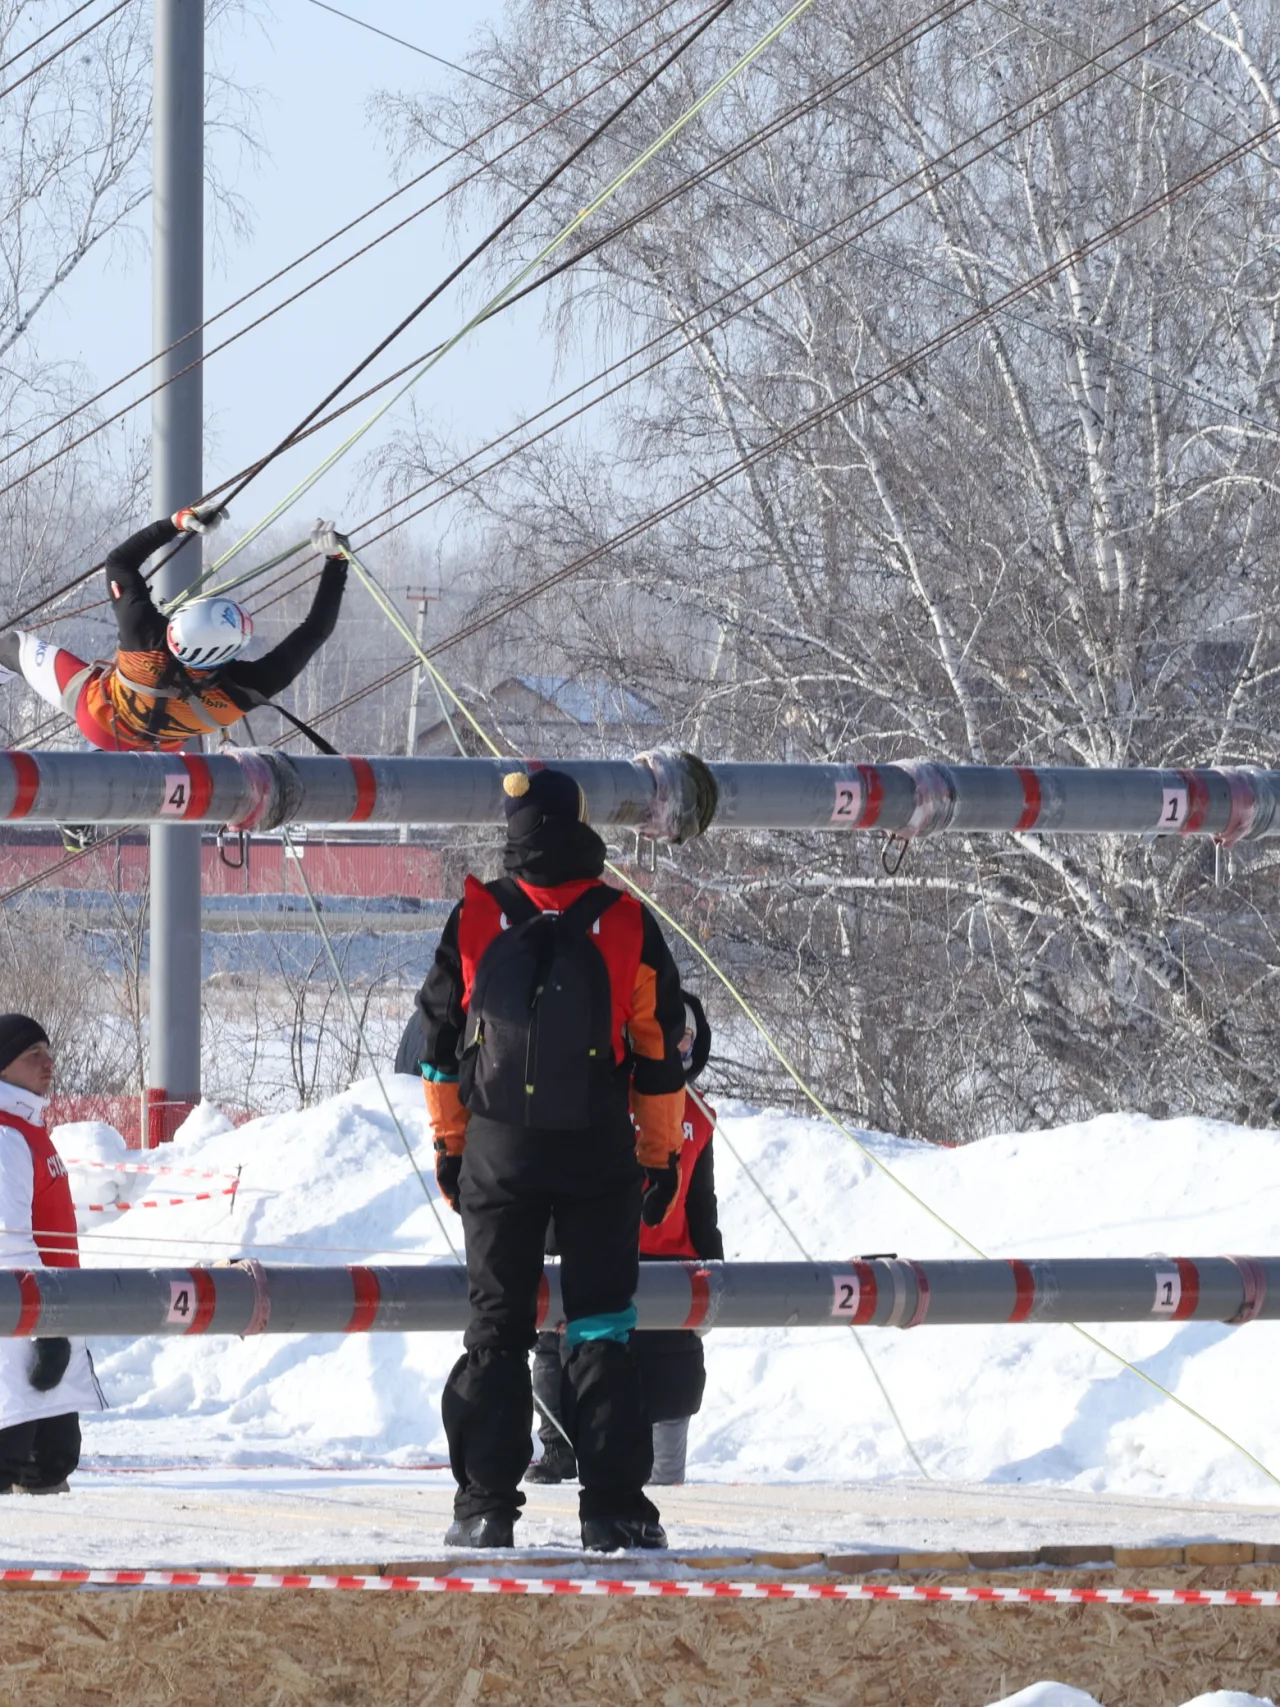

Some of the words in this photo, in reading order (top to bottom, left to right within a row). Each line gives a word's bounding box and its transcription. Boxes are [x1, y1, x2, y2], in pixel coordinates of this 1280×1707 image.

[169, 783, 186, 809] 4
[837, 790, 853, 814] 2
[1165, 798, 1178, 822] 1
[173, 1290, 190, 1316] 4
[839, 1284, 854, 1309] 2
[1160, 1281, 1174, 1307] 1
